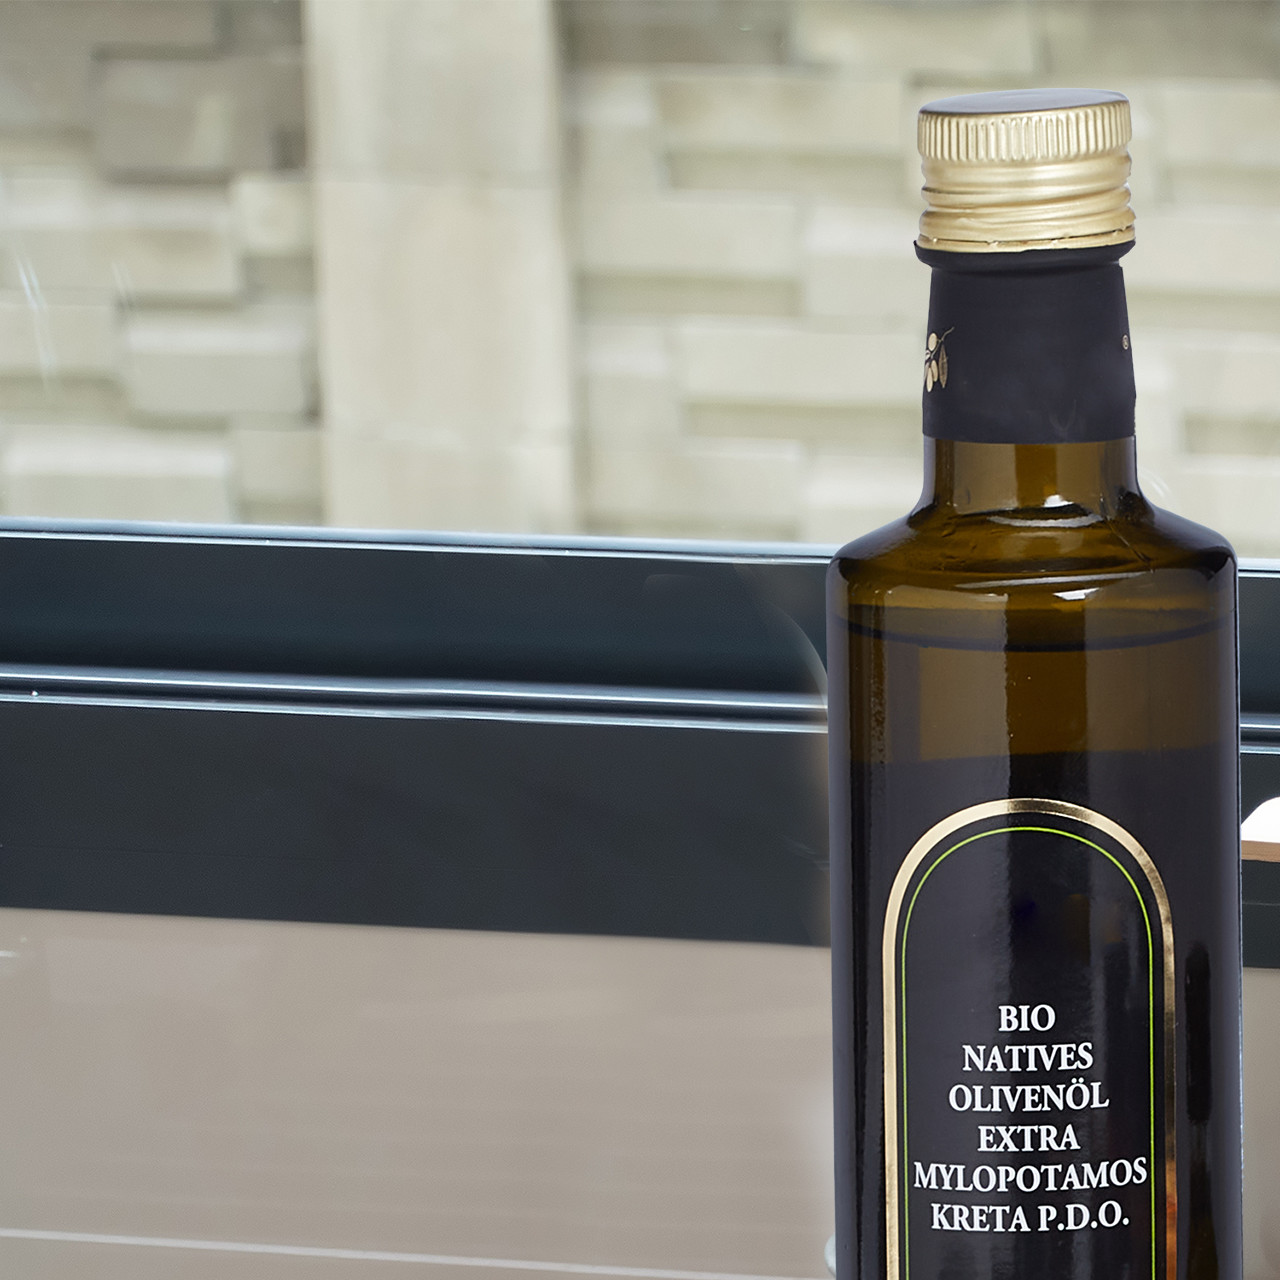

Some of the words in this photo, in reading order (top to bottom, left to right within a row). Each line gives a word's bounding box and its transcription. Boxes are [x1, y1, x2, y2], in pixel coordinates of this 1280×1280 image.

[998, 1004, 1056, 1032] BIO
[962, 1042, 1095, 1072] NATIVES
[949, 1077, 1110, 1112] OLIVENÖL
[977, 1123, 1081, 1152] EXTRA
[913, 1156, 1148, 1193] MYLOPOTAMOS
[931, 1202, 1031, 1232] KRETA
[1037, 1200, 1130, 1232] P.D.O.
